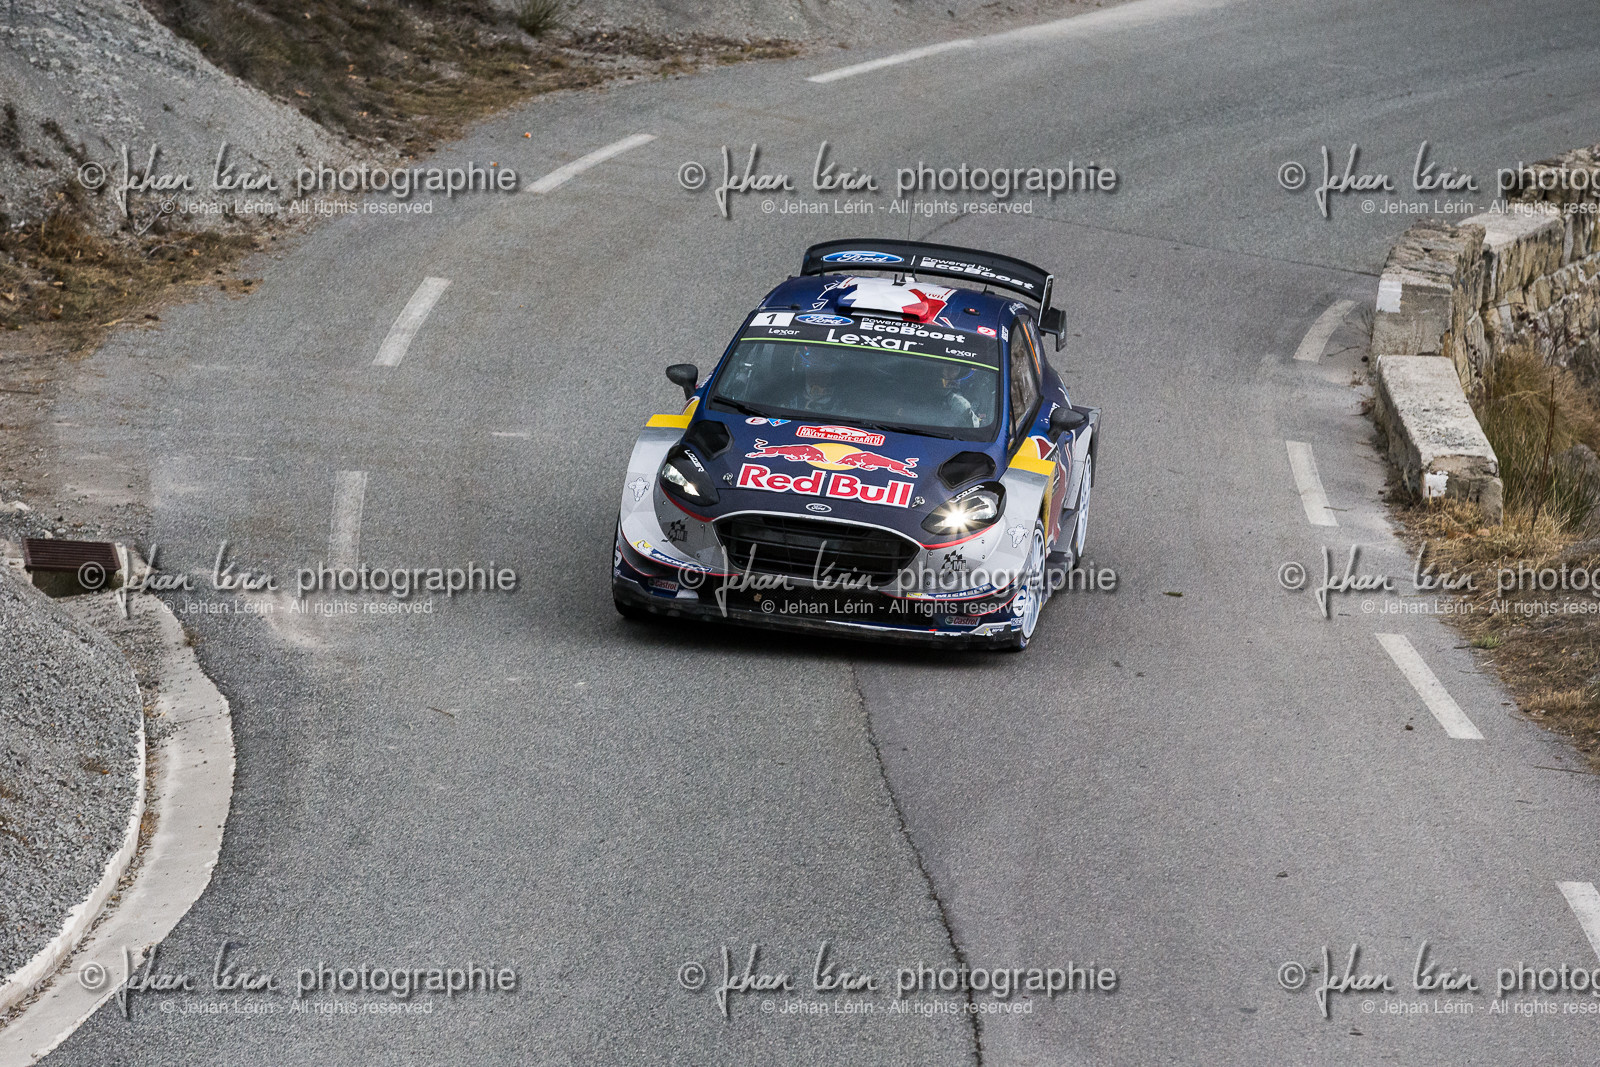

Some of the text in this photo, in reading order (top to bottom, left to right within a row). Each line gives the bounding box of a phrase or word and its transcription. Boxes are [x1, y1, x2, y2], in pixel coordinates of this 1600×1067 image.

[836, 252, 888, 263] Ford
[922, 256, 993, 272] Powered by
[919, 261, 1035, 290] EcoBoost
[766, 313, 778, 325] 1
[809, 314, 843, 325] Ford
[861, 317, 924, 331] Powered by
[768, 327, 800, 336] Lexar
[859, 322, 966, 344] EcoBoost
[826, 328, 917, 352] Lexar
[945, 347, 977, 358] Lexar
[737, 464, 913, 507] Red Bull
[655, 580, 677, 591] Castrol
[953, 617, 978, 626] Castrol
